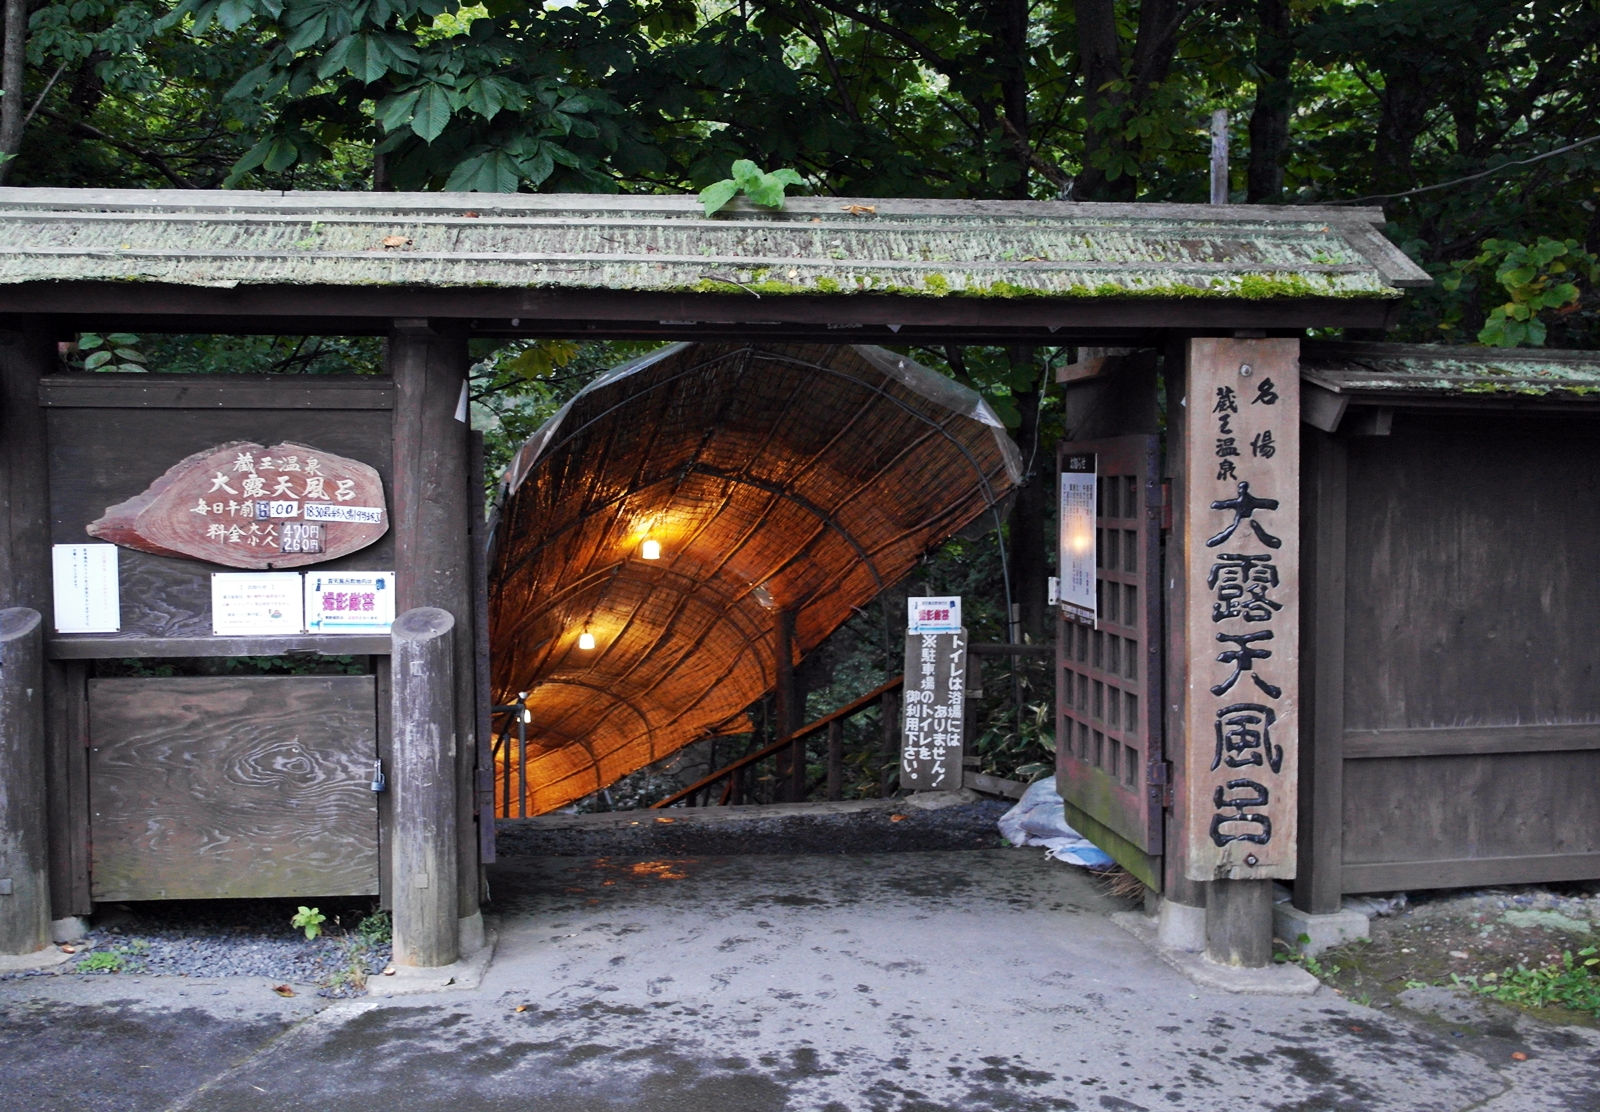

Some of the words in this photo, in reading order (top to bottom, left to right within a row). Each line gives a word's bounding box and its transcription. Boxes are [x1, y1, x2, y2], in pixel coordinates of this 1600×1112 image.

[1212, 386, 1241, 481] 蔵王温泉
[233, 452, 325, 477] 蔵王温泉
[208, 472, 357, 502] 大露天風呂
[206, 523, 248, 544] 料金
[248, 522, 279, 536] 大人
[284, 525, 319, 539] 470円
[247, 535, 279, 549] 小人
[284, 537, 319, 551] 260円
[322, 592, 375, 611] 撮影厳禁
[1206, 481, 1282, 848] 大露天風呂
[946, 635, 964, 747] トイレは浴場には
[903, 690, 920, 779] 御利用下さい。
